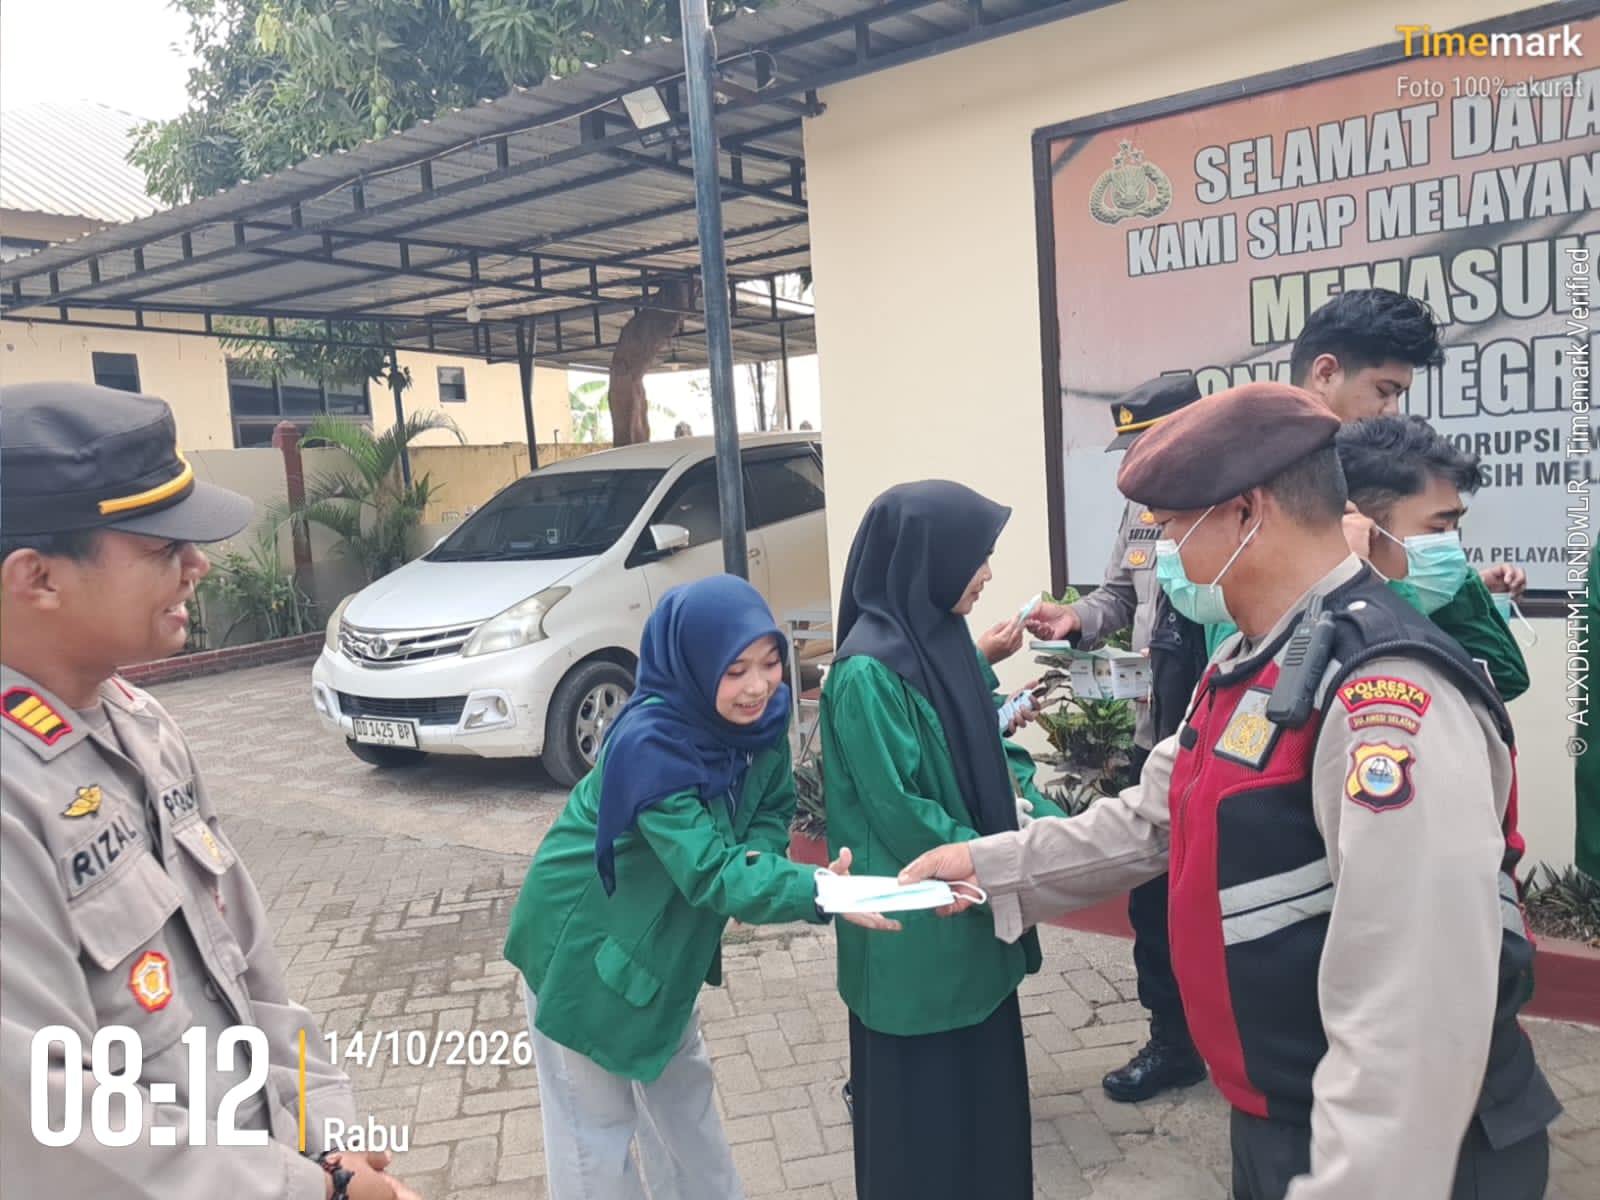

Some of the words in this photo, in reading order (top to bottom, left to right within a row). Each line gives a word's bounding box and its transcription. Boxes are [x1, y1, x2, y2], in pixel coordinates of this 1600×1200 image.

[1195, 101, 1439, 204] SELAMAT
[1127, 213, 1238, 277] KAMI
[1247, 195, 1356, 259] SIAP
[1440, 427, 1560, 456] ORUPSI
[1343, 679, 1425, 704] POLRESTA
[369, 722, 394, 738] 1425
[72, 815, 137, 886] RIZAL
